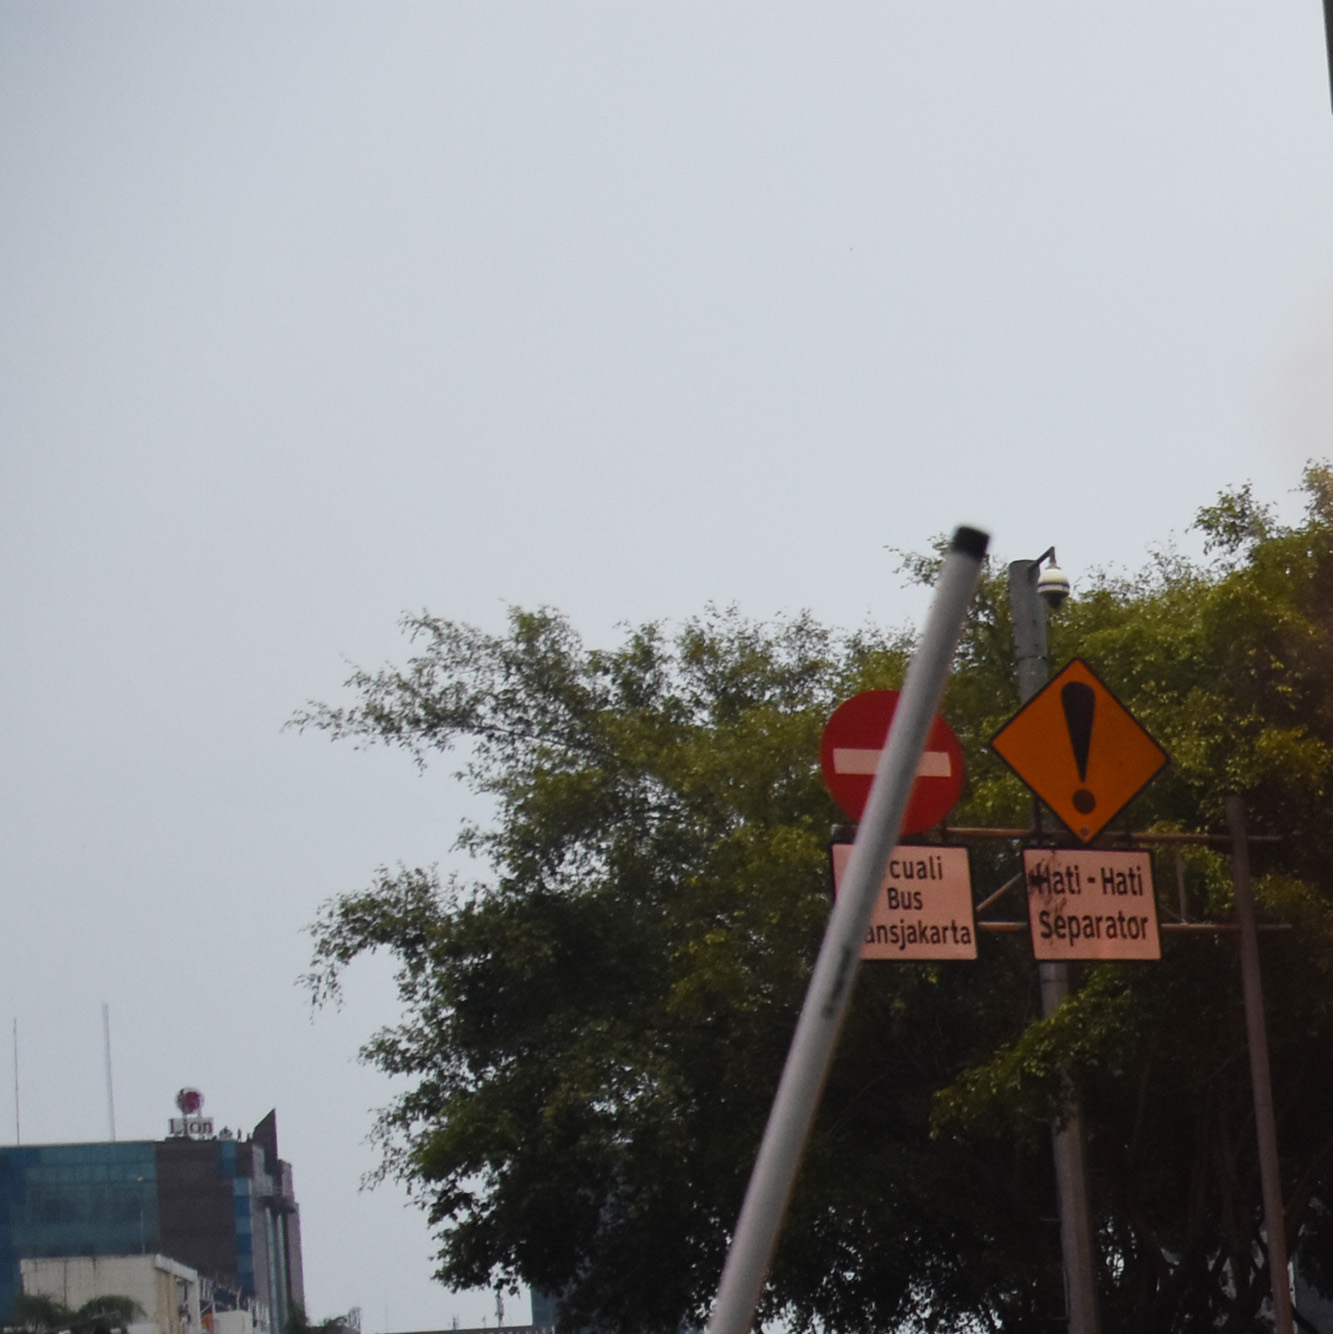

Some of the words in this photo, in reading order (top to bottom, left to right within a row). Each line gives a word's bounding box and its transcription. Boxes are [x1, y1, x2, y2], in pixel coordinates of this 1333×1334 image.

[889, 856, 943, 880] cuali
[1036, 863, 1081, 895] Hati
[1101, 865, 1143, 896] Hati
[887, 887, 923, 910] Bus
[865, 919, 972, 950] ansjakarta
[1039, 910, 1148, 947] Separator
[168, 1118, 214, 1137] Lion
